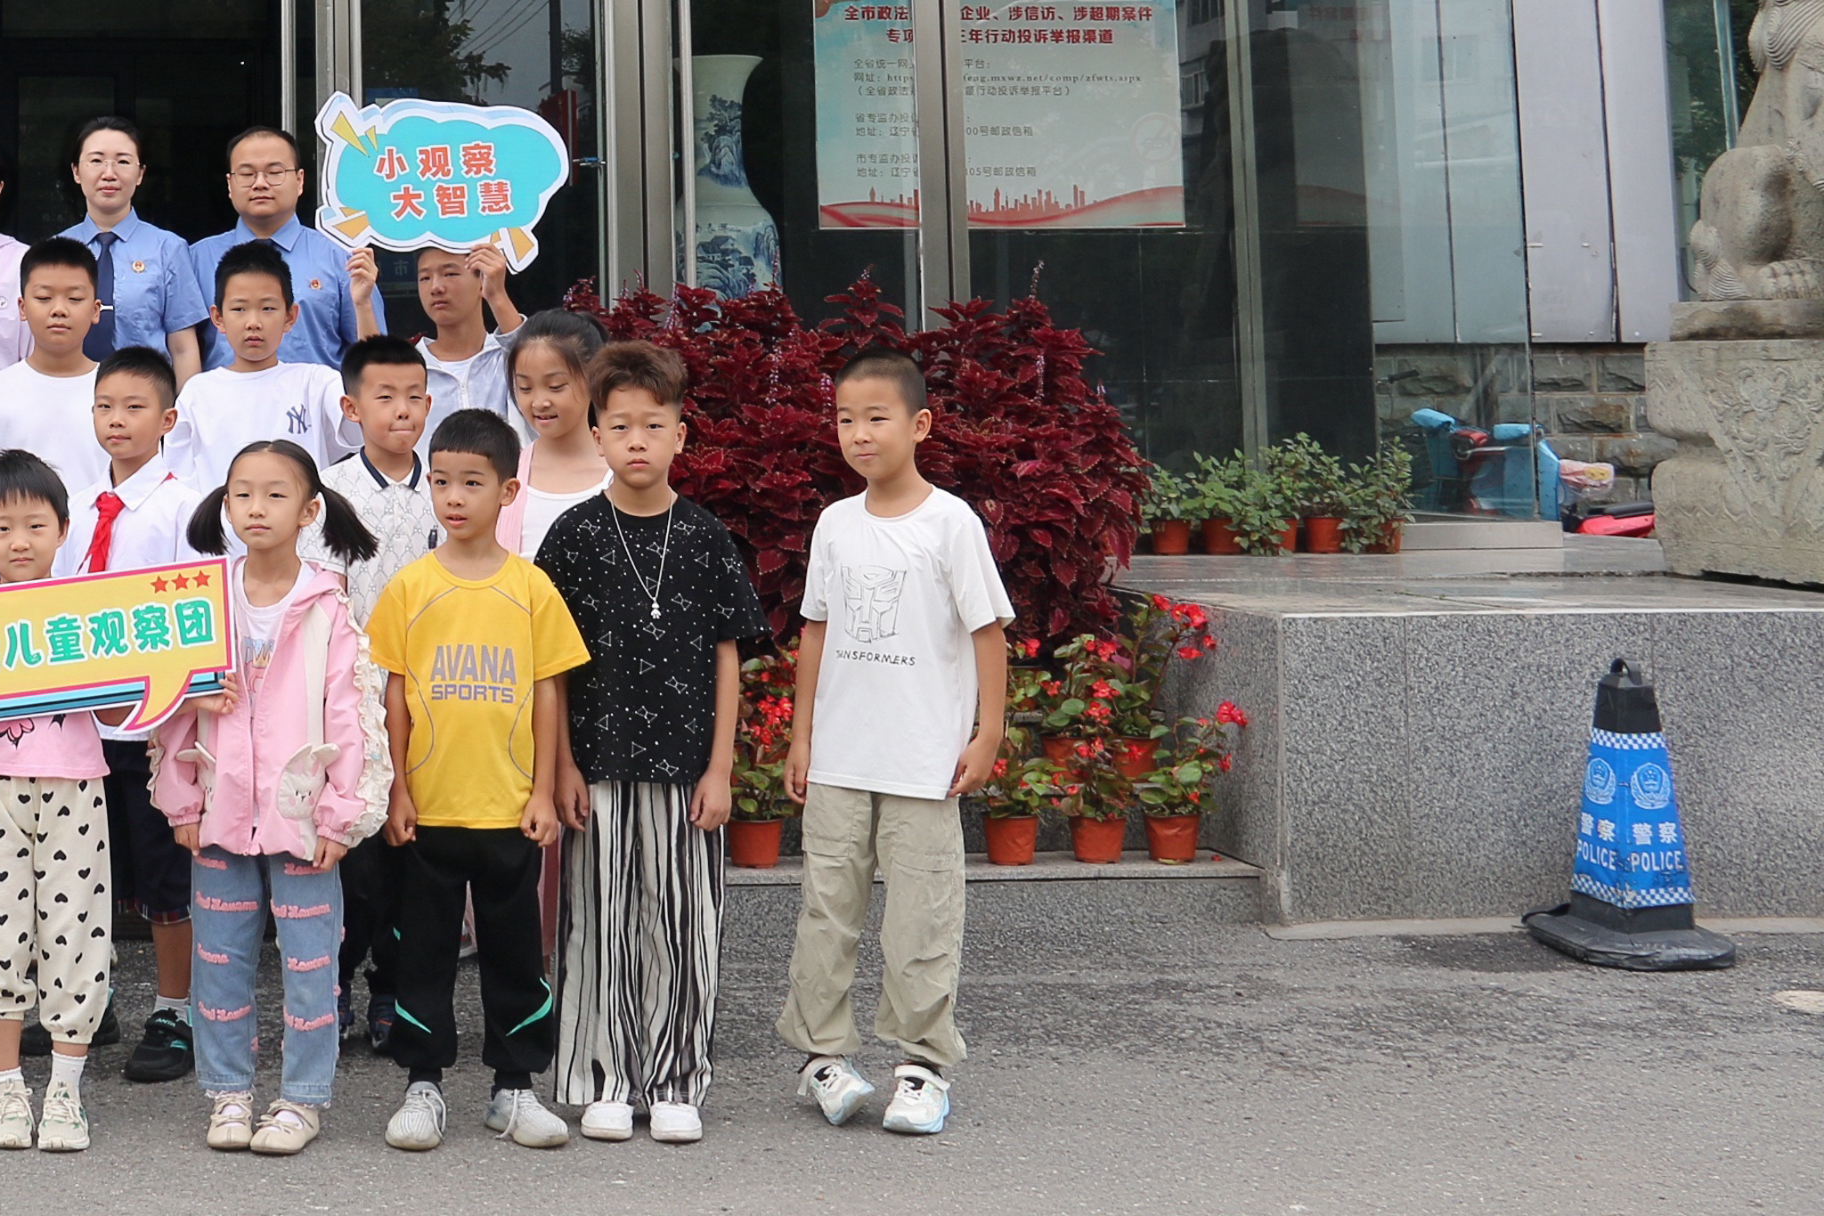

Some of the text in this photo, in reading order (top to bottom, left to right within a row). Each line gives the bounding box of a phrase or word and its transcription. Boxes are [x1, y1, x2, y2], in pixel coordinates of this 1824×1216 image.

[374, 142, 495, 181] 小观察
[391, 180, 513, 219] 大智慧
[429, 644, 517, 685] AVANA
[431, 683, 514, 704] SPORTS
[1581, 812, 1616, 843] 警察
[1631, 822, 1678, 846] 警察
[1576, 838, 1618, 871] POLICE
[1630, 850, 1684, 873] POLICE
